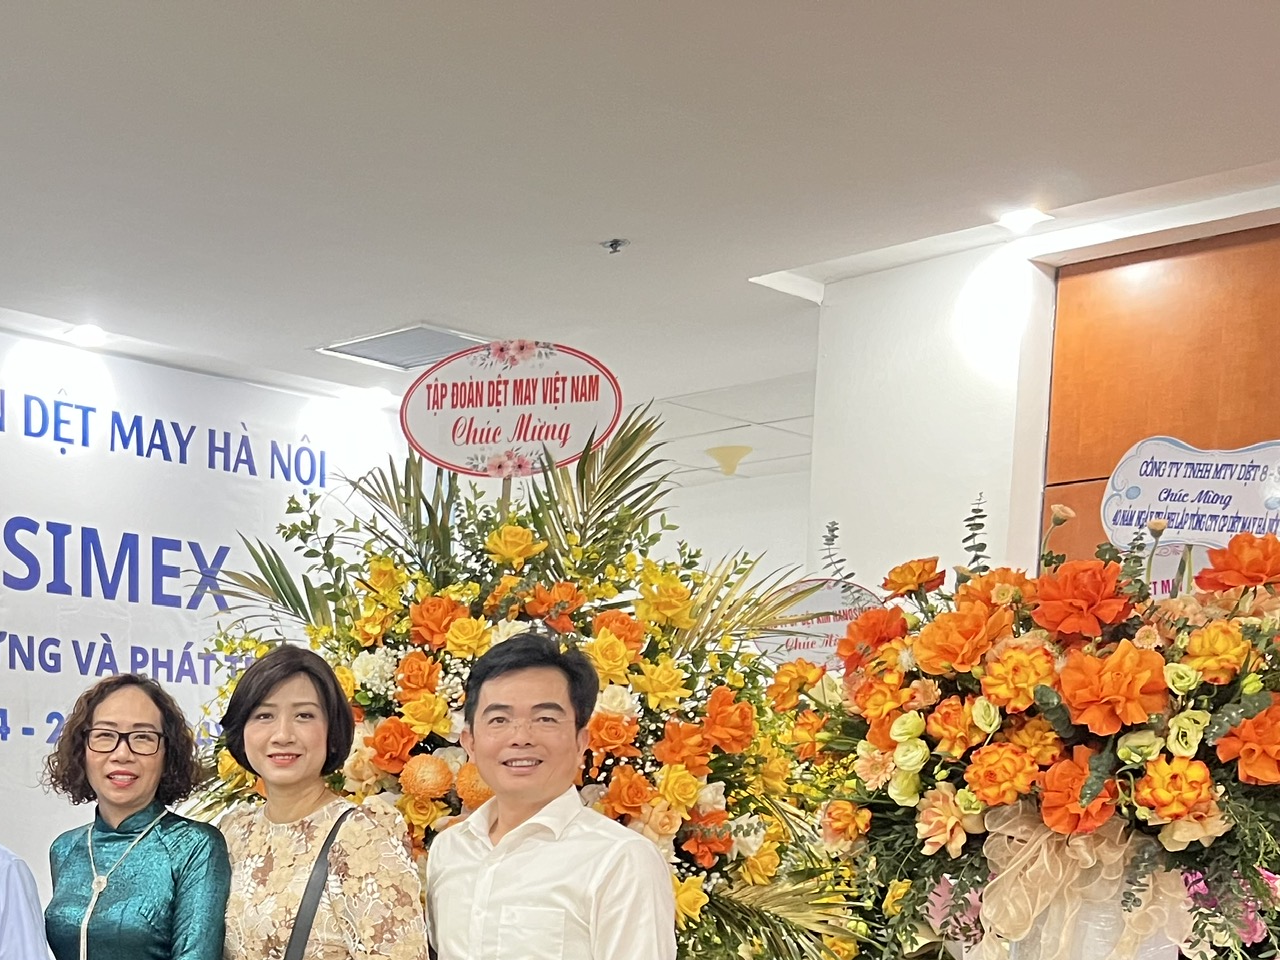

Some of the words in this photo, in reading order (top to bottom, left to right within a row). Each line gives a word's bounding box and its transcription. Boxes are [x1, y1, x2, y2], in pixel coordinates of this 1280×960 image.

[426, 377, 448, 416] TẬP
[451, 375, 483, 409] ĐOÀN
[487, 373, 509, 413] DỆT
[513, 377, 538, 406] MAY
[542, 371, 567, 410] VIỆT
[570, 374, 600, 403] NAM
[24, 387, 96, 455] DỆT
[110, 411, 196, 464] MAY
[208, 422, 257, 476] HÀ
[270, 434, 326, 495] NỘI
[451, 416, 502, 446] Chúc
[507, 413, 571, 448] Mừng
[1139, 456, 1166, 478] CÔNG
[1167, 461, 1184, 478] TY
[1183, 462, 1213, 480] TNHH
[1211, 463, 1238, 480] MTV
[1237, 459, 1261, 487] DỆT
[1260, 465, 1269, 482] 8
[1158, 487, 1189, 503] Chúc
[72, 633, 119, 677] VÀ
[131, 642, 216, 685] PHÁT
